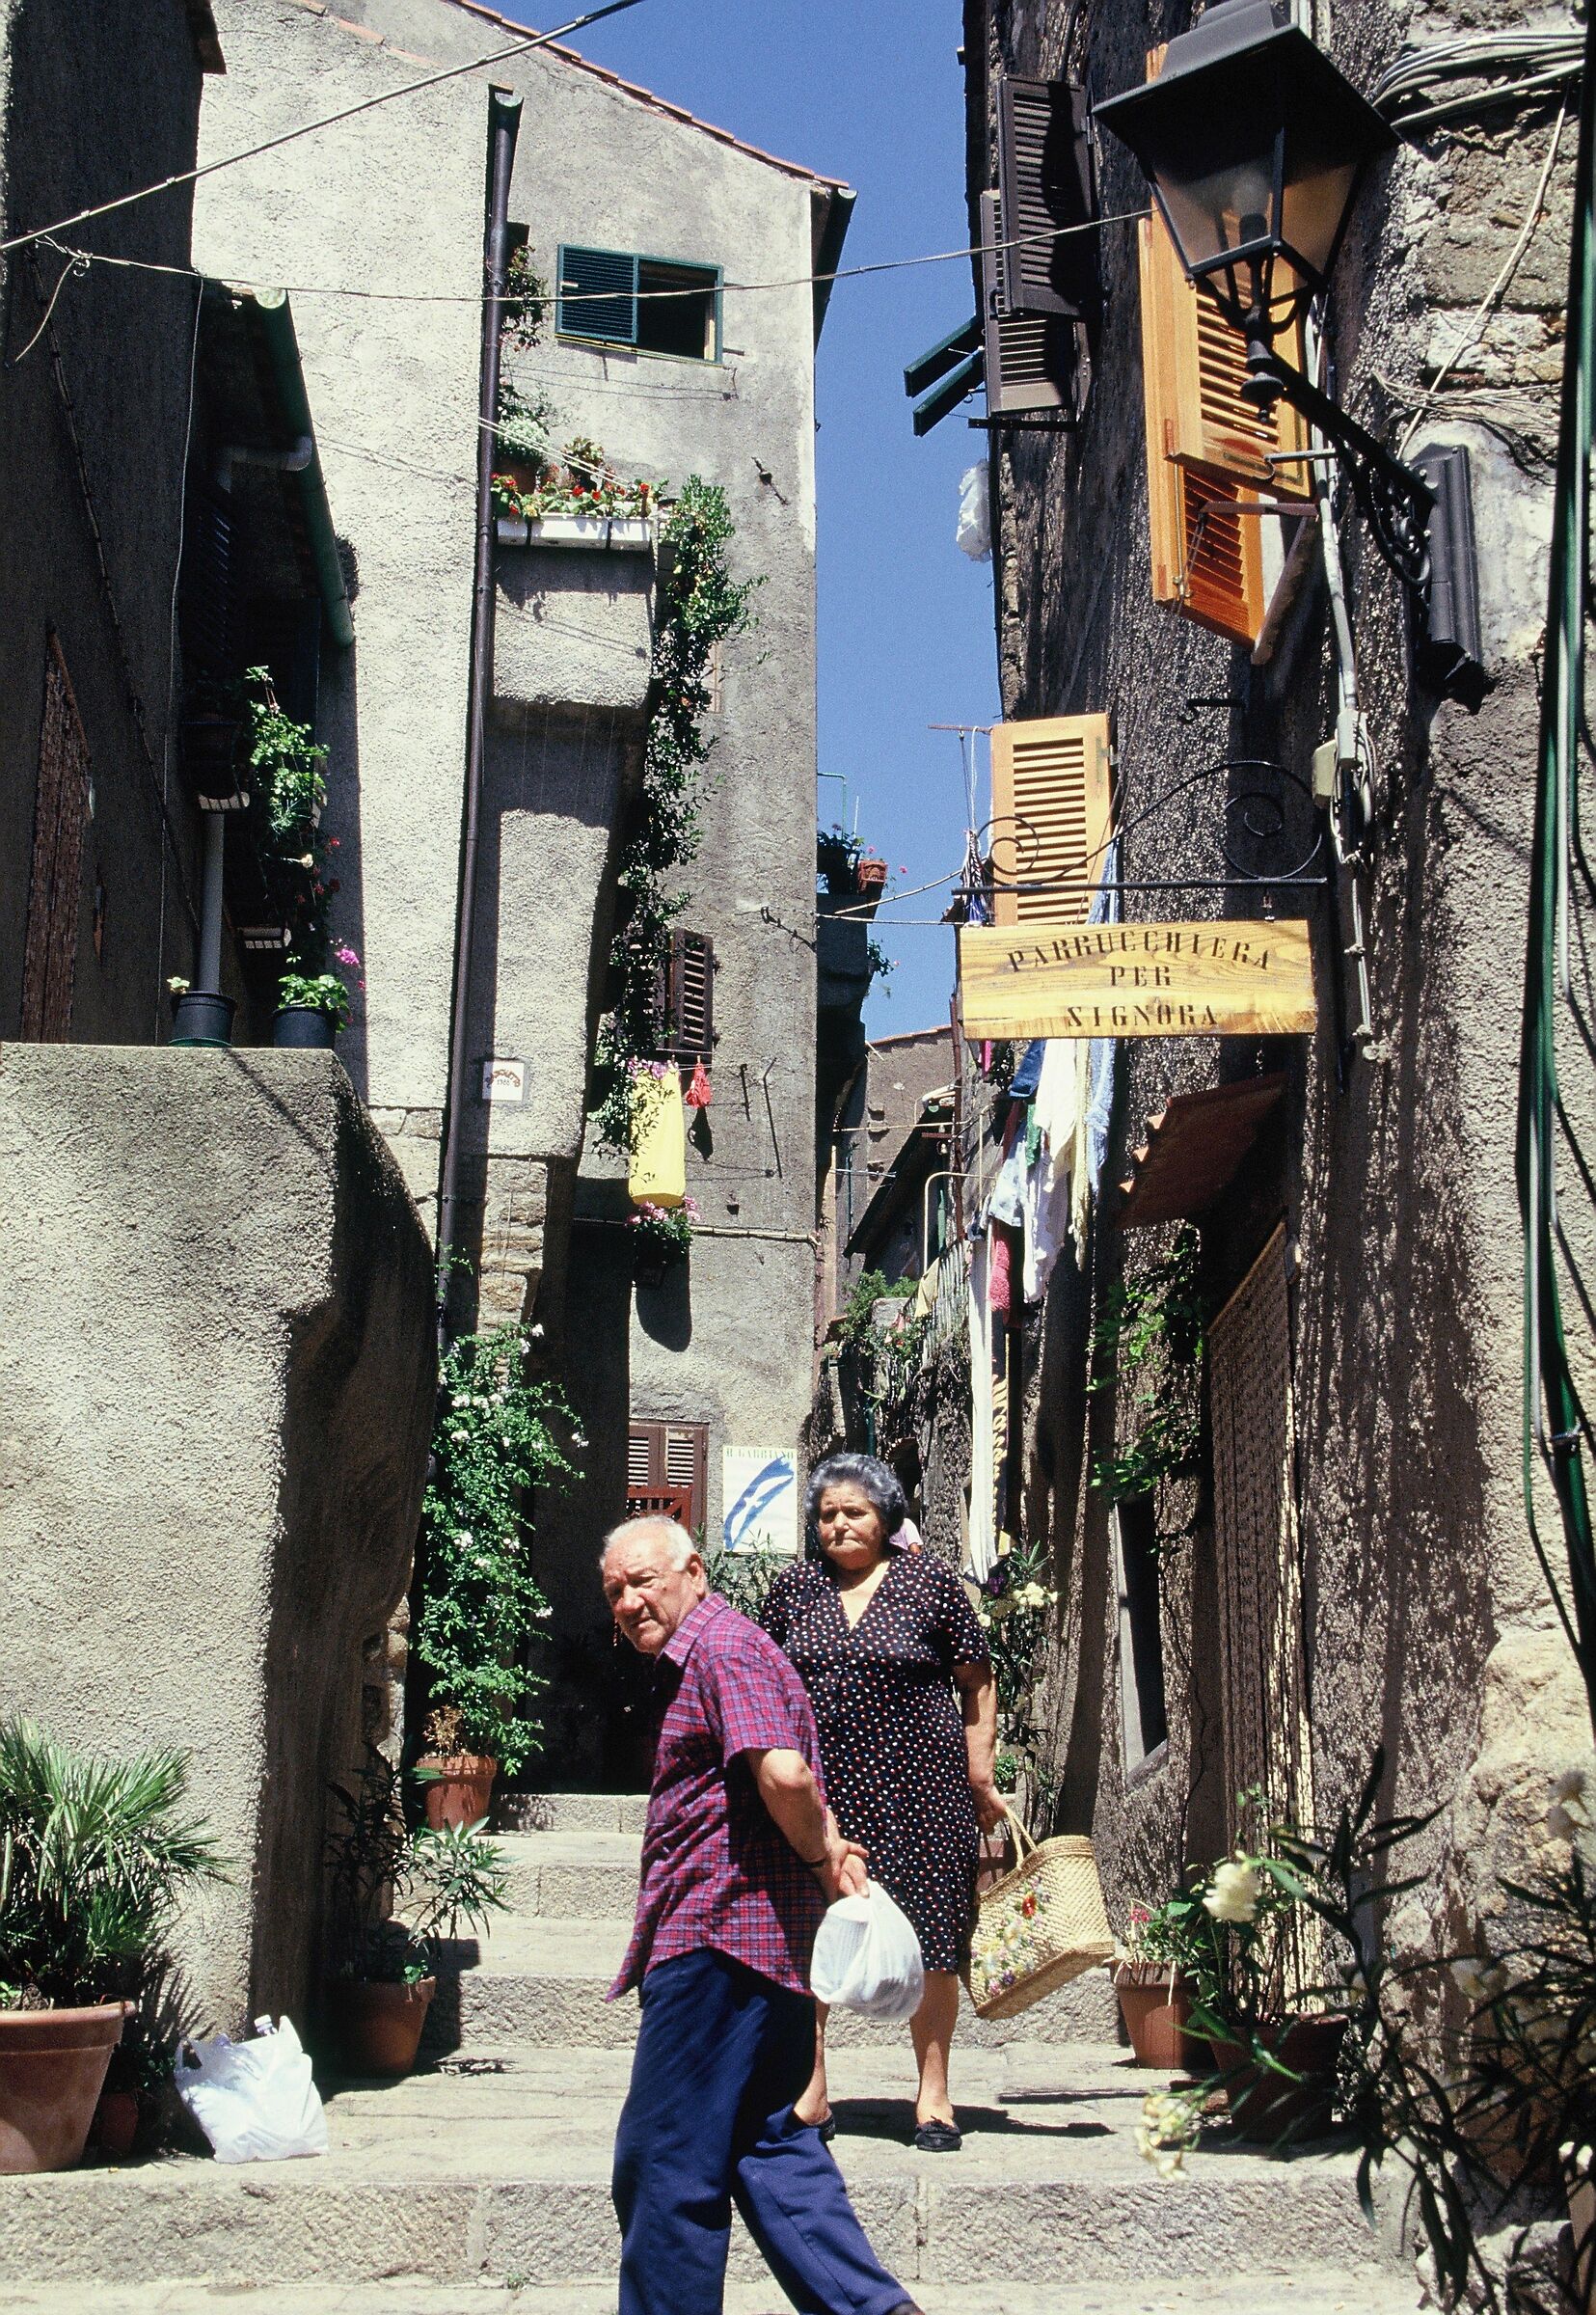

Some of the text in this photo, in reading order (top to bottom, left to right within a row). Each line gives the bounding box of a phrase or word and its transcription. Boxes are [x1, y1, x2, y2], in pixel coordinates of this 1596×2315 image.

[1007, 930, 1270, 972] PARRUCCHIERA
[1110, 966, 1172, 987] PER
[1067, 1004, 1219, 1027] SIGNORA
